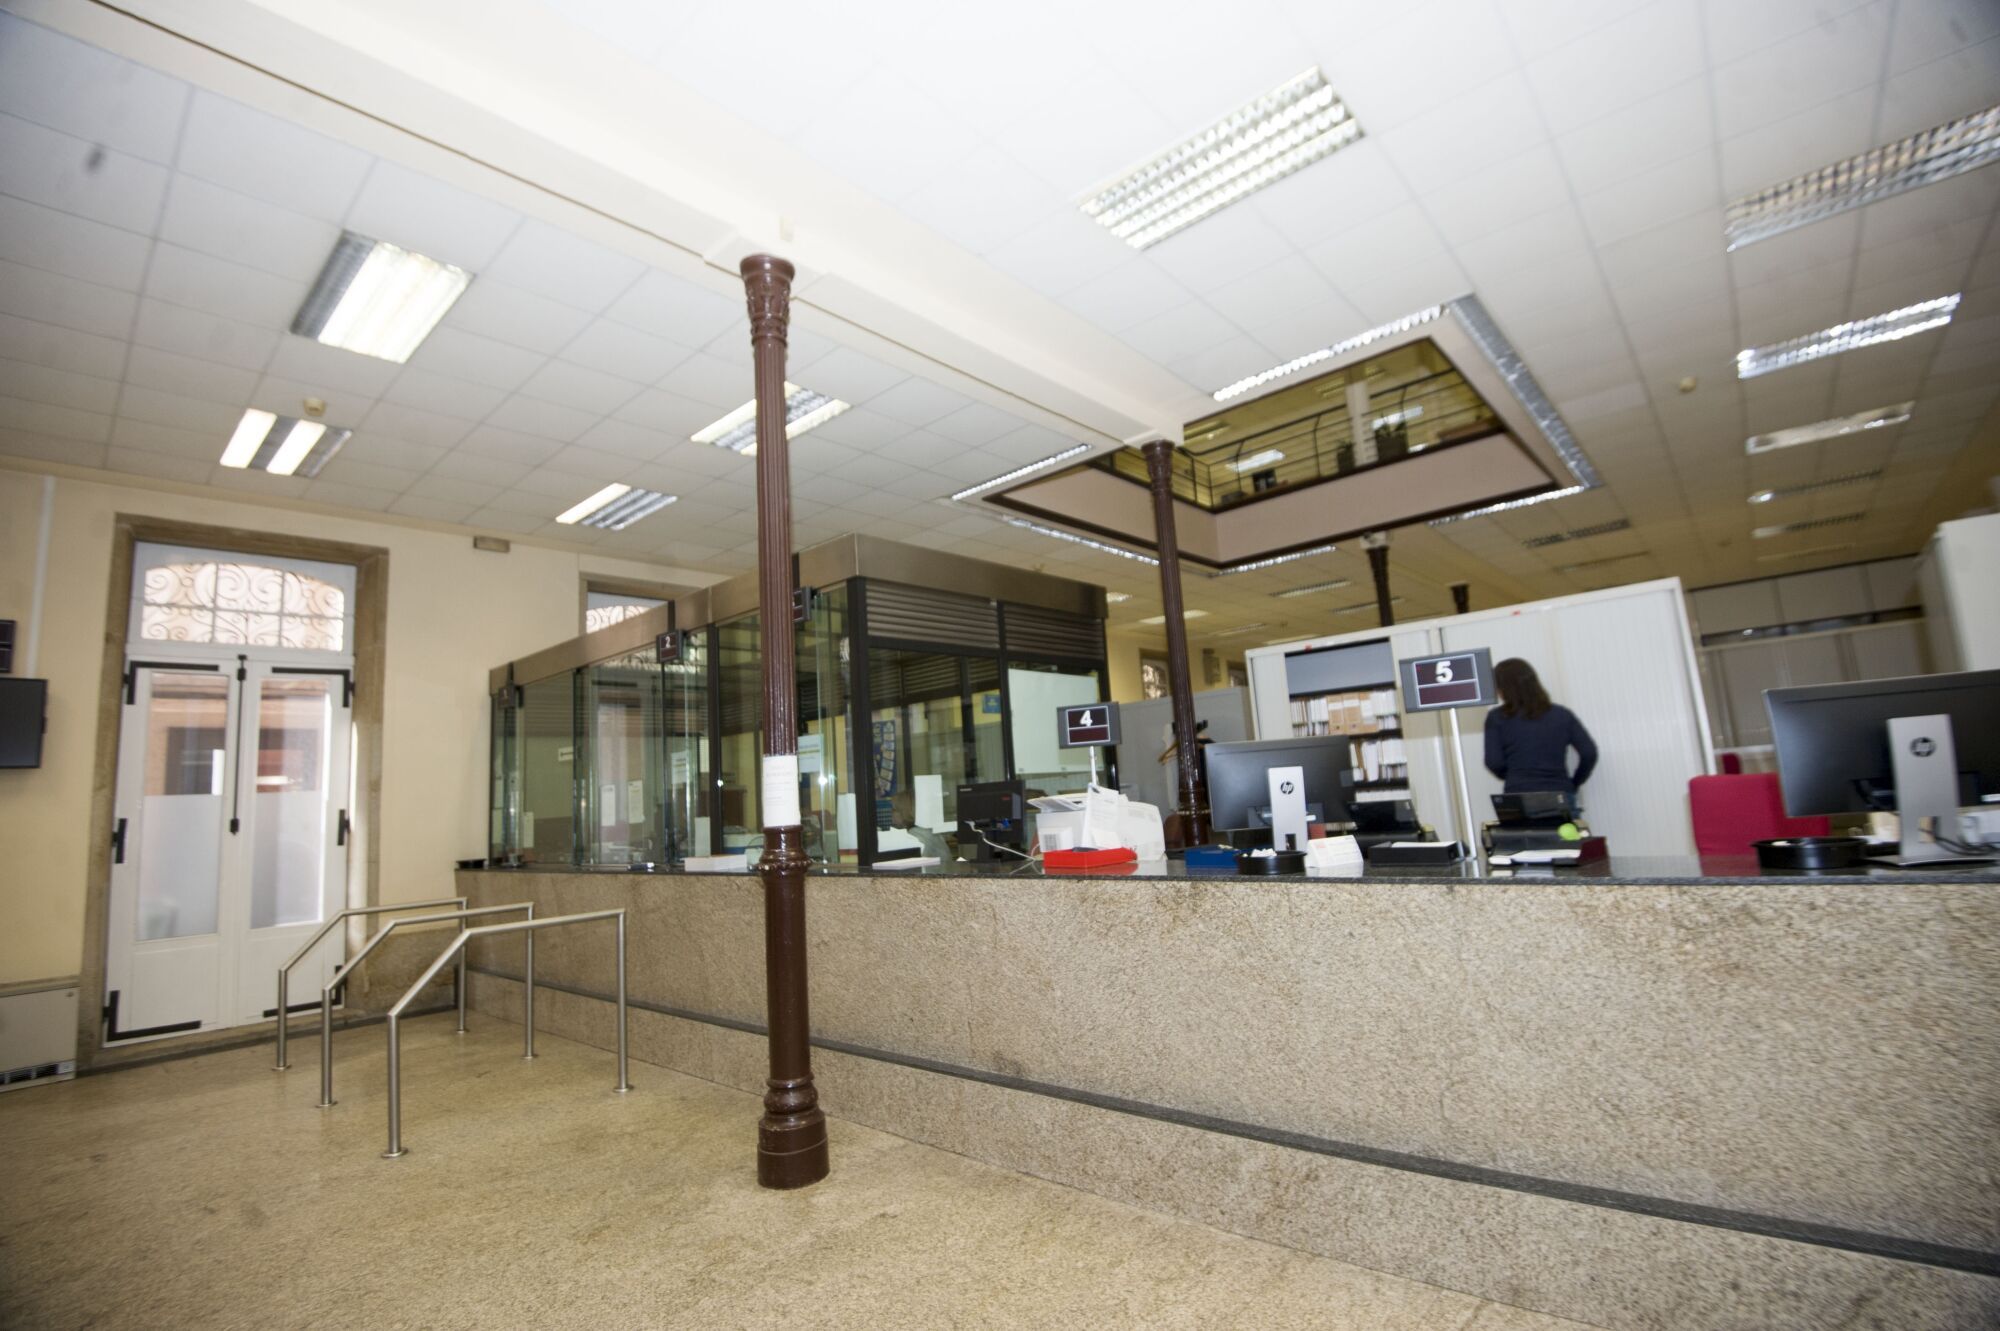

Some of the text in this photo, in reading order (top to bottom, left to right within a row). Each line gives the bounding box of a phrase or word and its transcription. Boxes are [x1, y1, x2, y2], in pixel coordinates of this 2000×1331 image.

[665, 636, 671, 648] 2
[1435, 660, 1454, 683] 5
[1080, 709, 1093, 727] 4
[1281, 781, 1294, 795] hp
